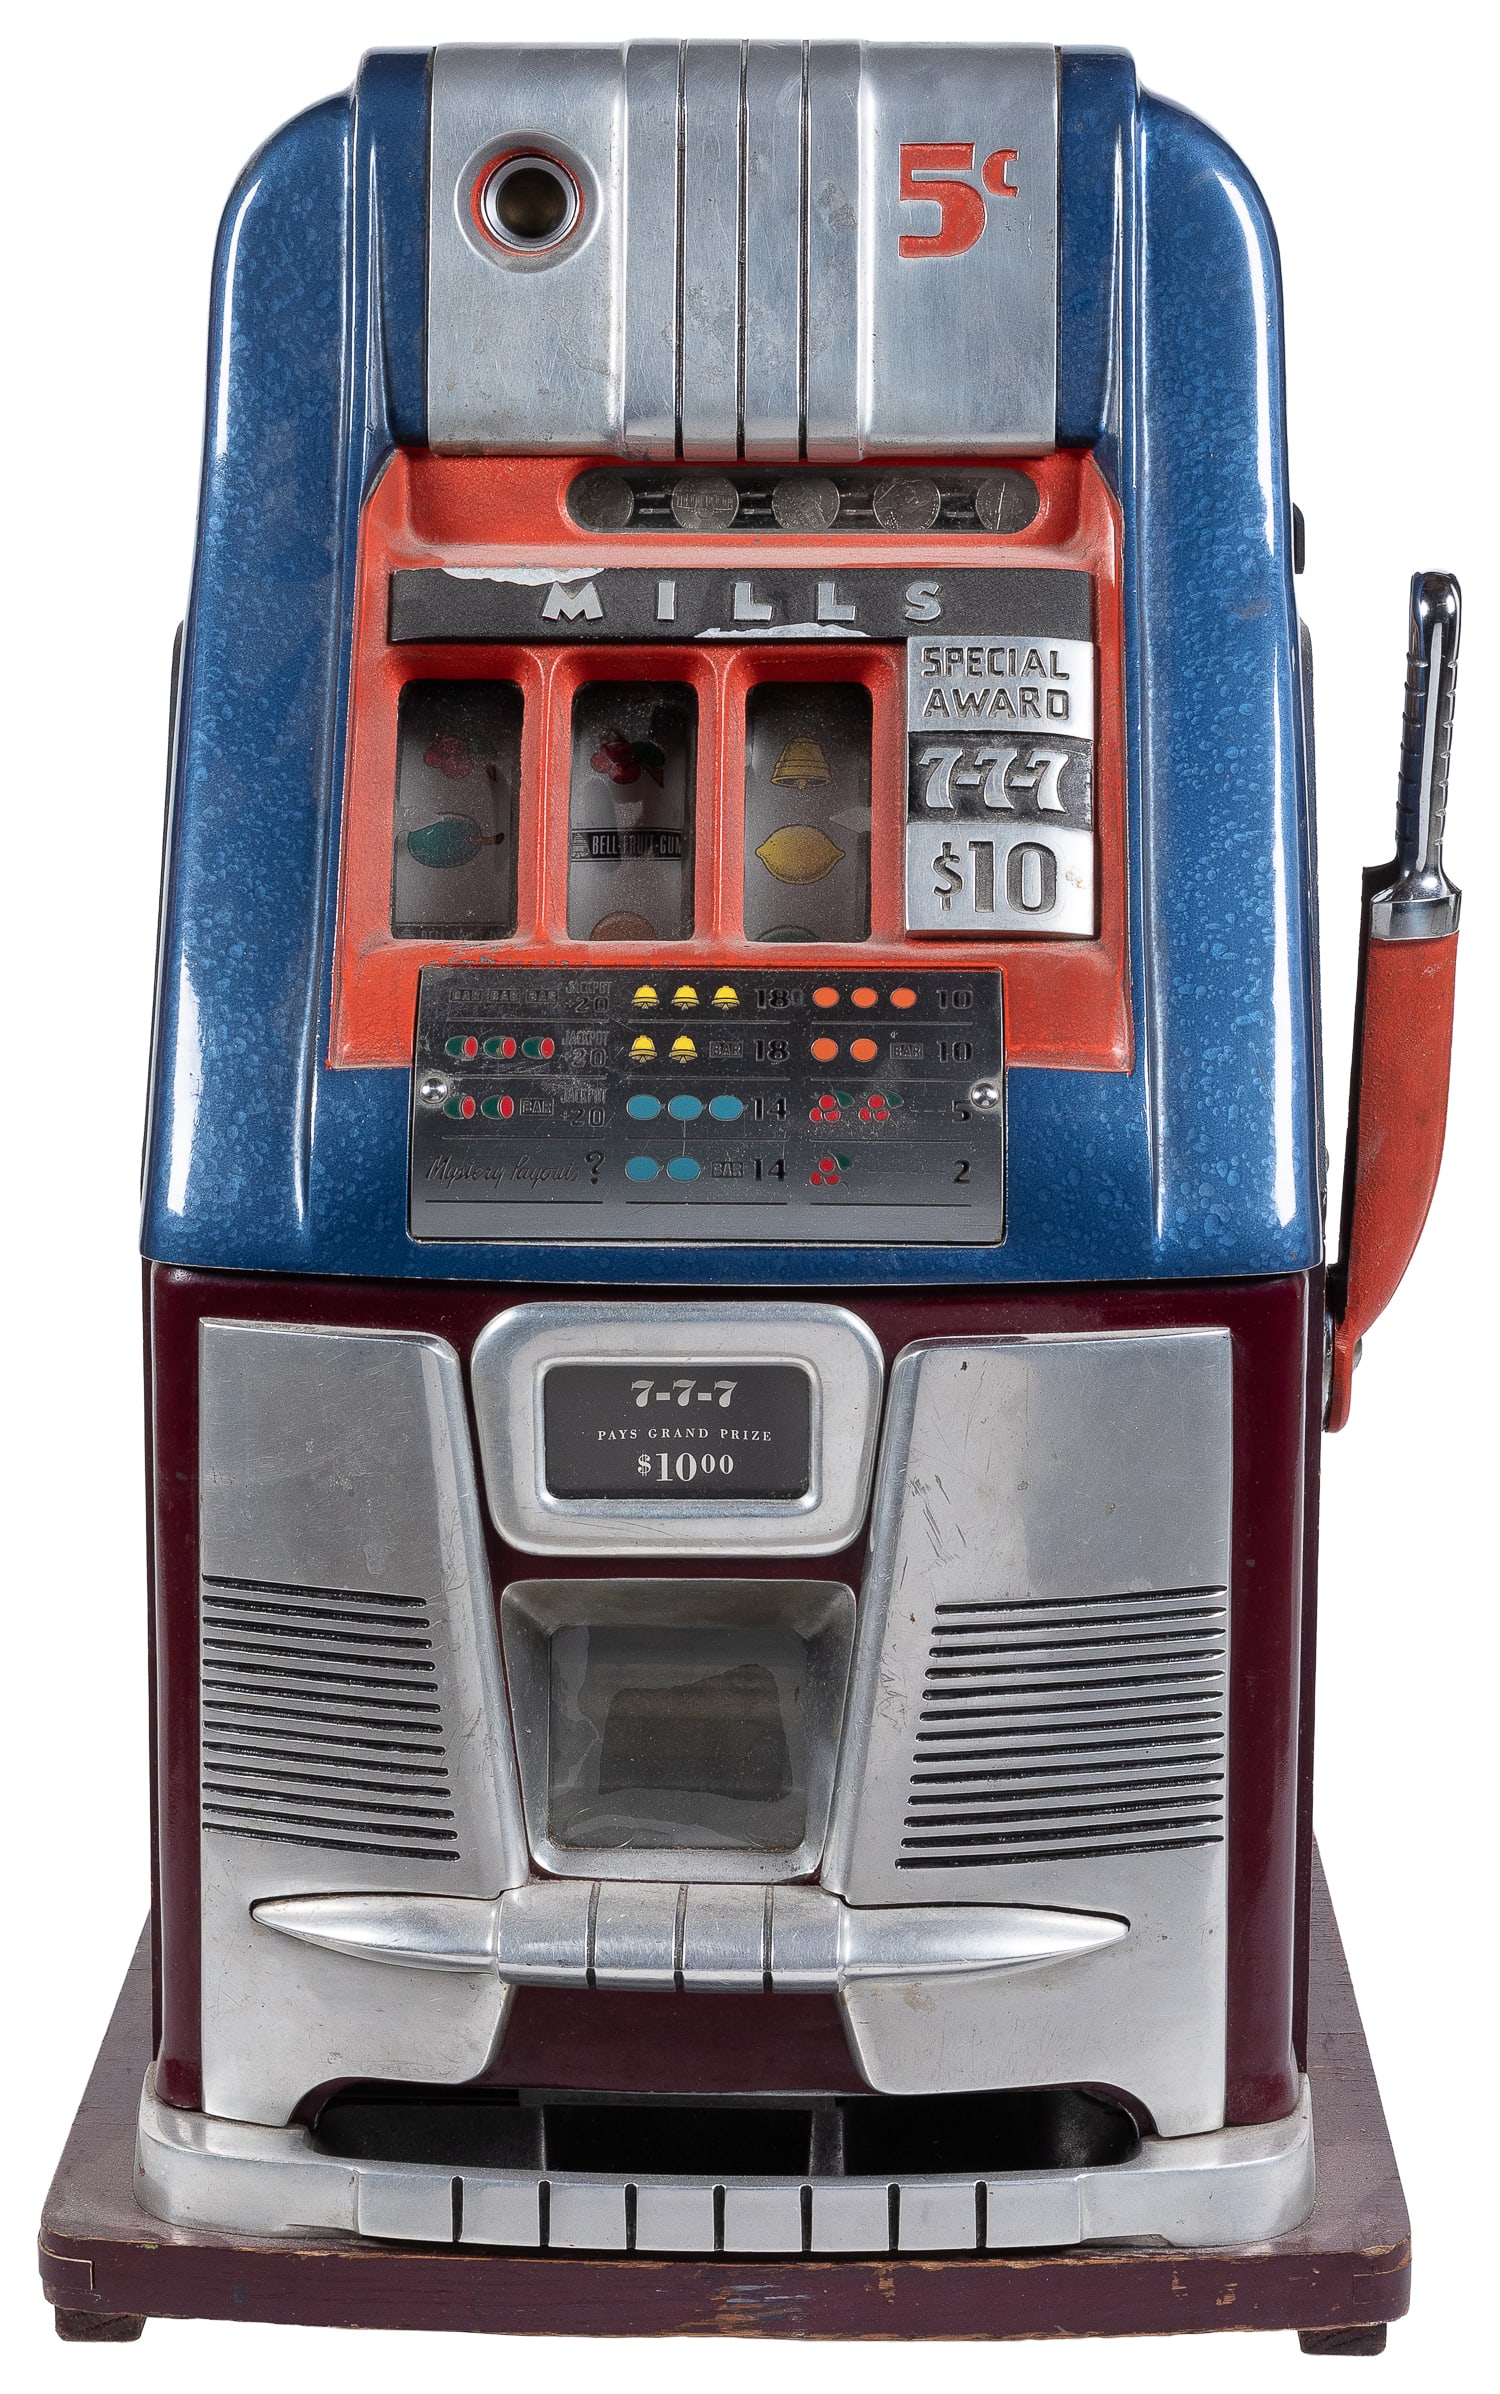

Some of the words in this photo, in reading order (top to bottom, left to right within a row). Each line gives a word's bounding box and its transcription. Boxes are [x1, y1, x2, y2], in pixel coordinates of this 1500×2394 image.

[542, 581, 942, 621] MILLS
[921, 646, 1070, 681] SPECIAL
[923, 687, 1070, 721] AWARD
[918, 748, 1069, 813] 7-7-7
[931, 840, 1057, 915] $10
[936, 989, 973, 1009] 10
[711, 1043, 742, 1057] BAR
[753, 1038, 790, 1062] 18
[892, 1045, 922, 1058] BAR
[936, 1041, 973, 1063] 10
[521, 1100, 552, 1114] BAR
[751, 1096, 790, 1121] 14
[951, 1099, 973, 1123] 5
[425, 1154, 506, 1189] Mystery
[712, 1163, 743, 1178] BAR
[753, 1158, 788, 1182] 14
[952, 1159, 971, 1184] 2
[631, 1379, 738, 1408] 7-7-7
[597, 1429, 638, 1441] PAYS
[648, 1428, 709, 1440] GRAND
[720, 1428, 772, 1442] PRIZE
